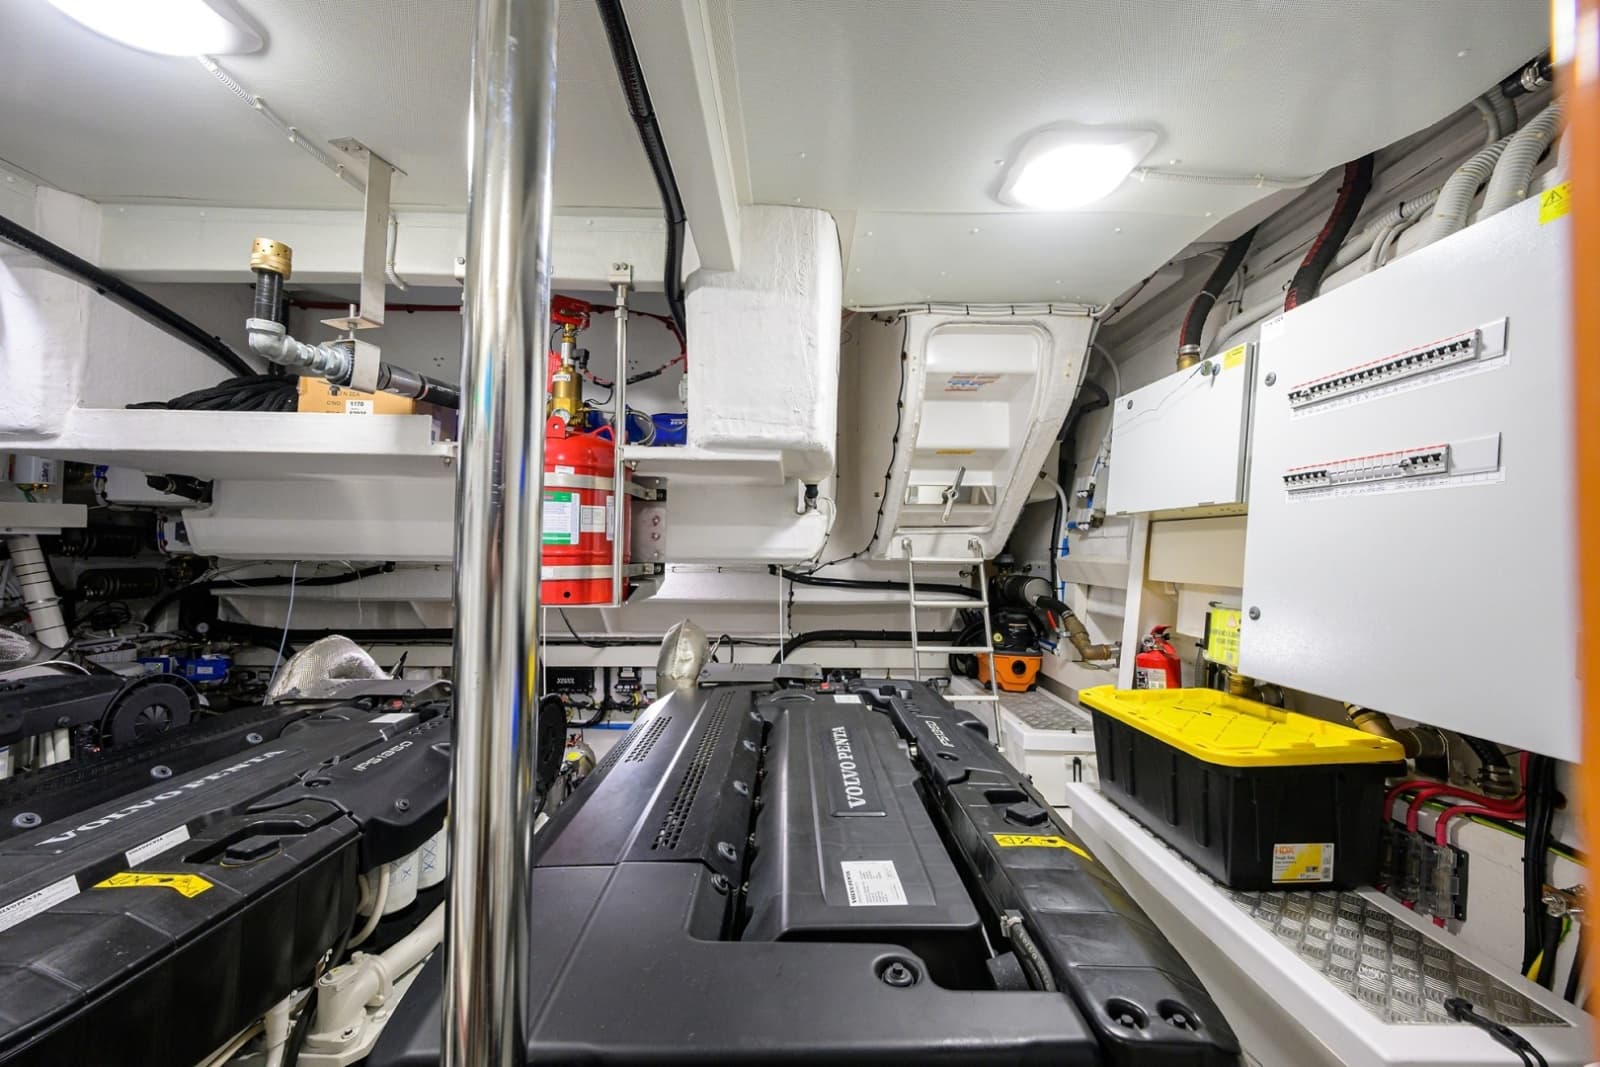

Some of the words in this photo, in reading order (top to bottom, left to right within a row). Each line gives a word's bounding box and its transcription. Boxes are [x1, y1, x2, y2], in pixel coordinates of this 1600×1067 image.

[832, 726, 854, 760] PENTA
[34, 790, 182, 847] VOLVO
[183, 750, 287, 789] PENTA
[840, 760, 867, 808] VOLVO
